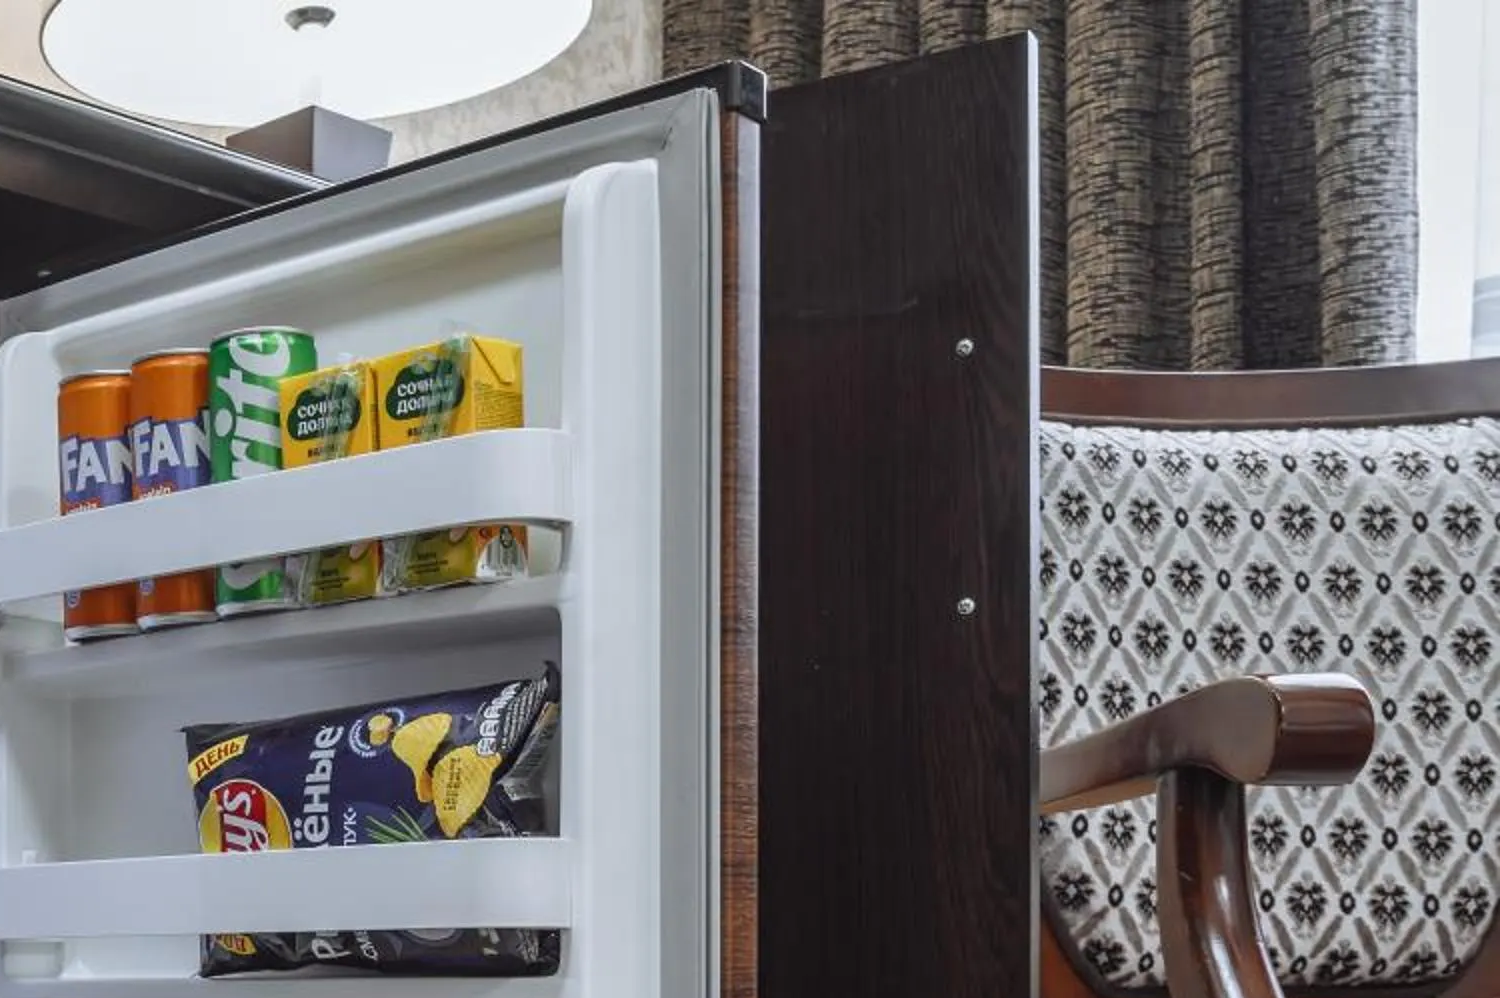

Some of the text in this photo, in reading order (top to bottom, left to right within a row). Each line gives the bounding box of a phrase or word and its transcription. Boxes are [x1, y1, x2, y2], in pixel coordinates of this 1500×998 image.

[133, 410, 211, 478] FAN
[214, 333, 290, 480] rite
[61, 437, 132, 495] FAN
[293, 725, 344, 848] ёные
